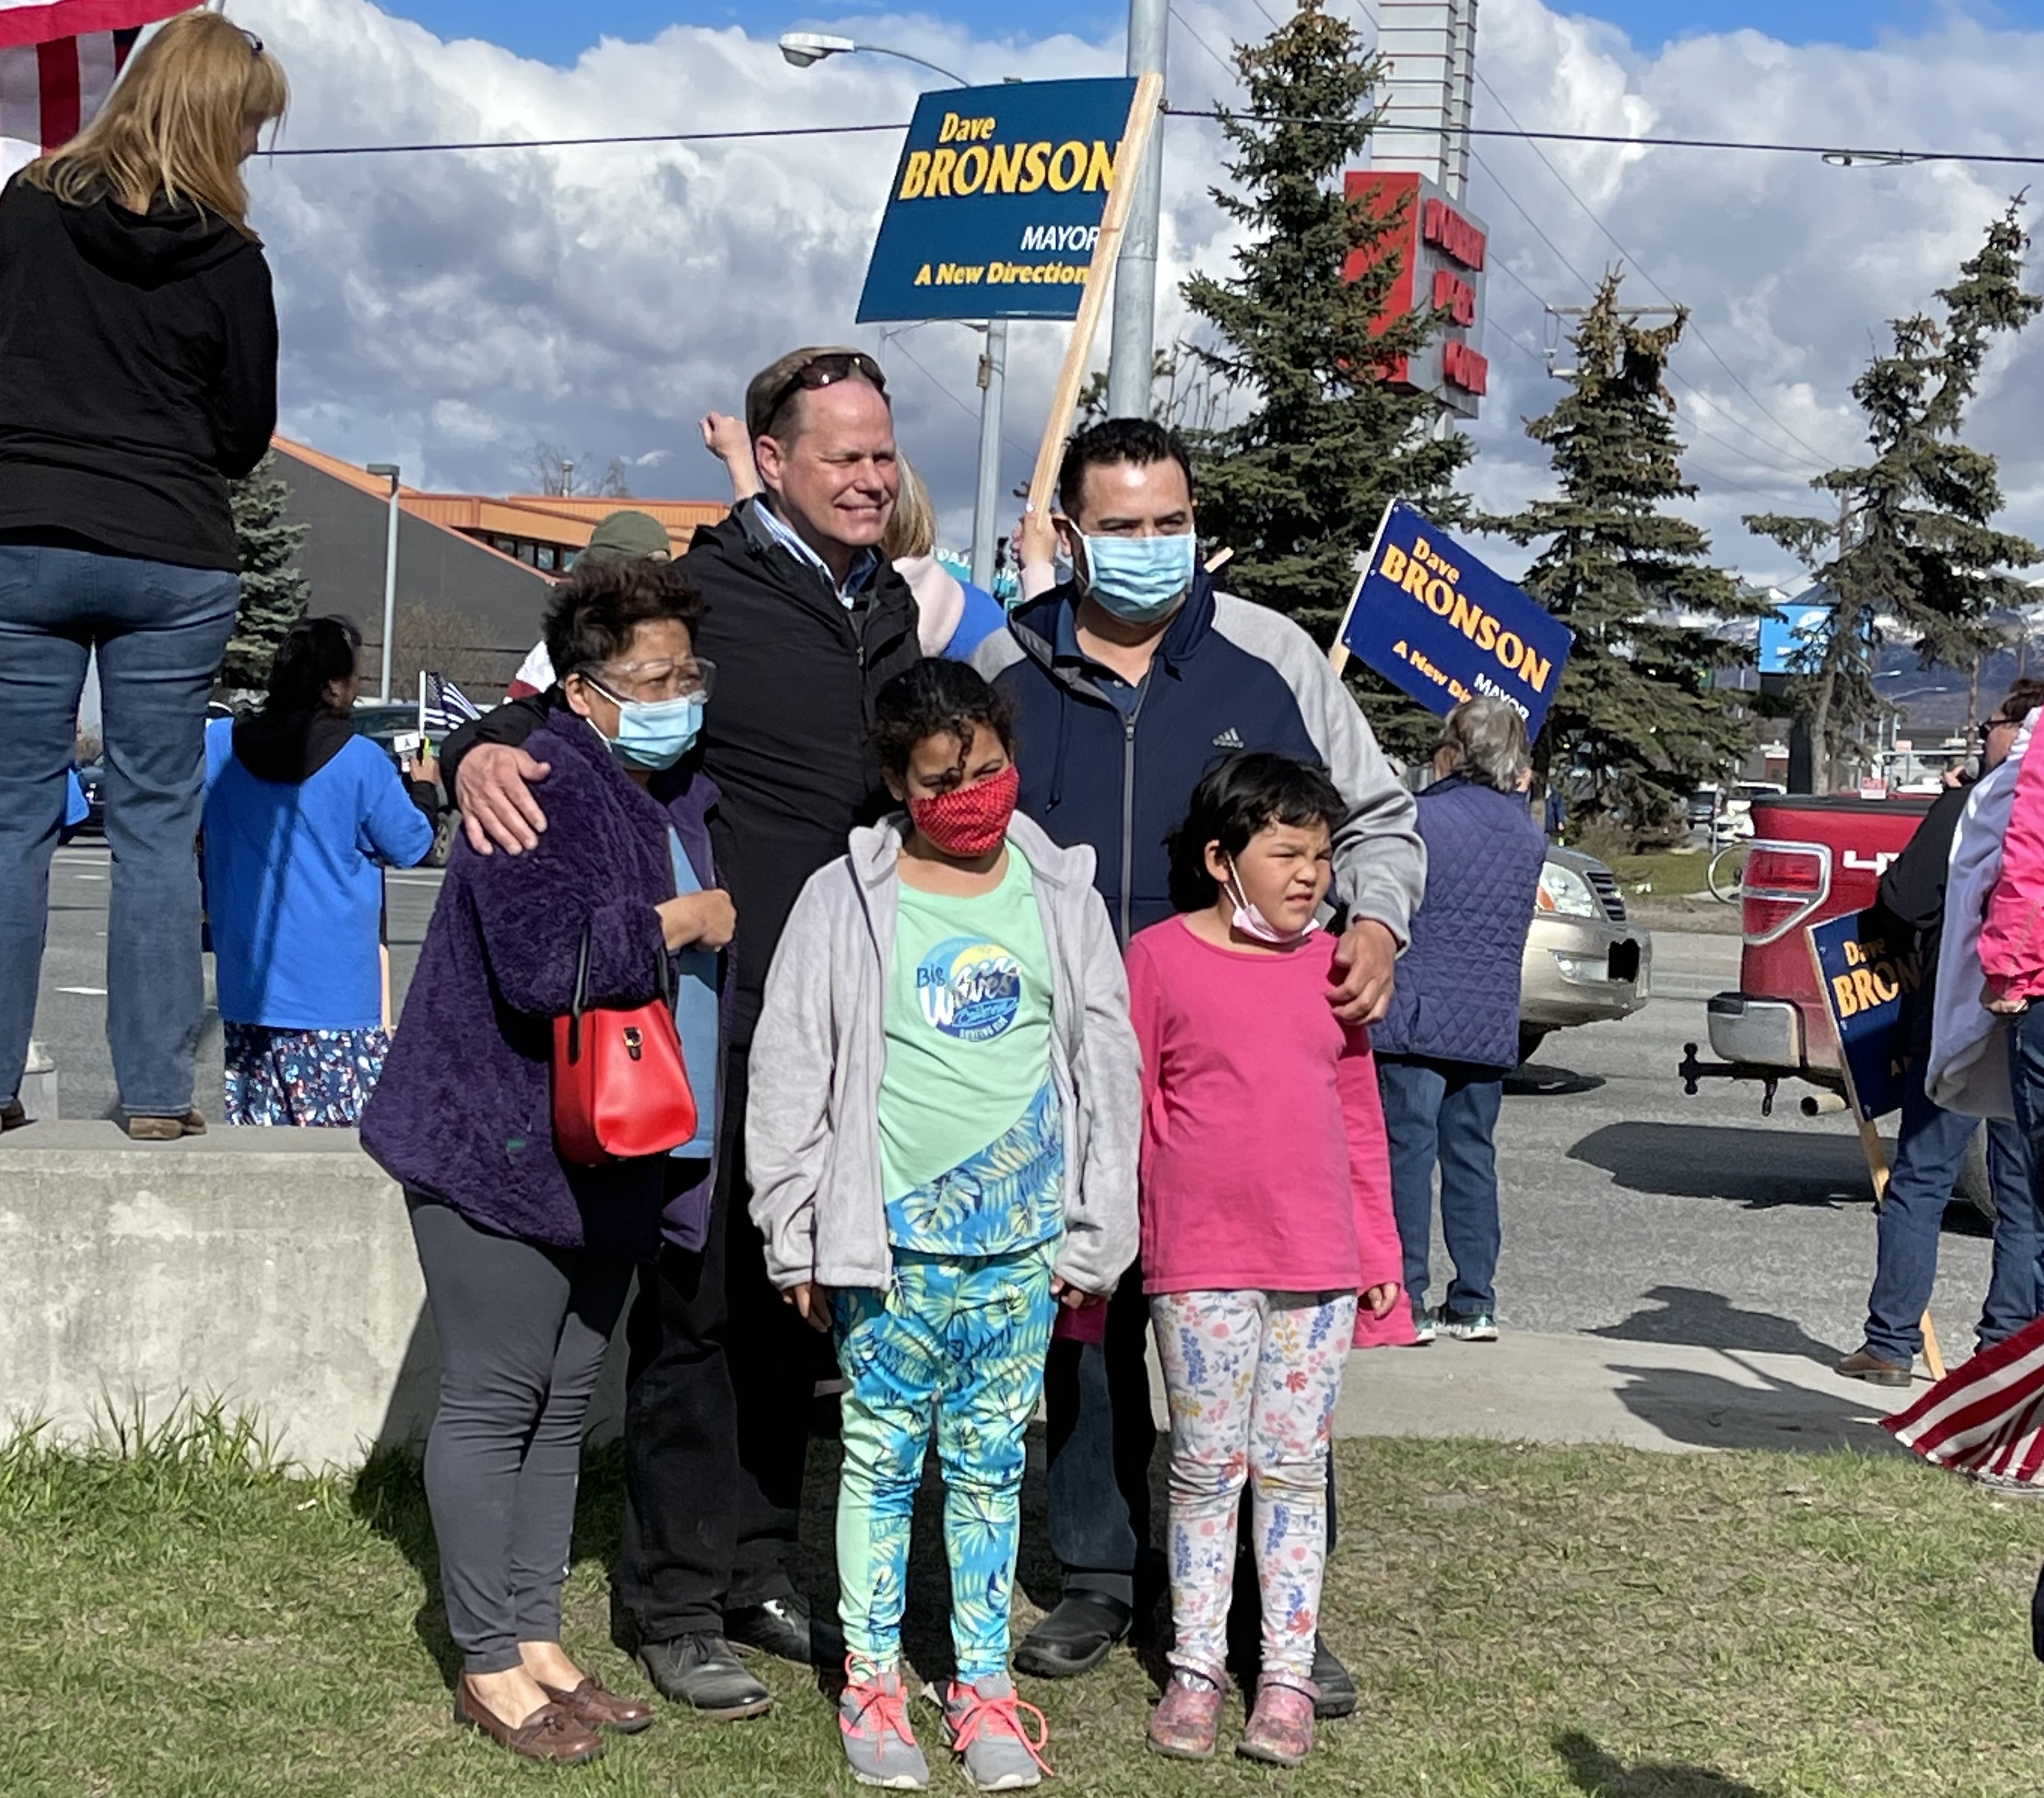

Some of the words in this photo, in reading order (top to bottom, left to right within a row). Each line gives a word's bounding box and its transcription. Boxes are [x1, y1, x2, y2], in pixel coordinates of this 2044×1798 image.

[939, 111, 996, 143] Dave
[898, 140, 1123, 200] BRONSON
[1021, 225, 1101, 251] MAYOR
[914, 263, 932, 286] A
[935, 262, 985, 286] New
[987, 261, 1091, 285] Direction
[1412, 536, 1459, 584] Dave
[1380, 543, 1552, 693] BRONSON
[1393, 640, 1408, 659] A
[1410, 650, 1448, 686] New
